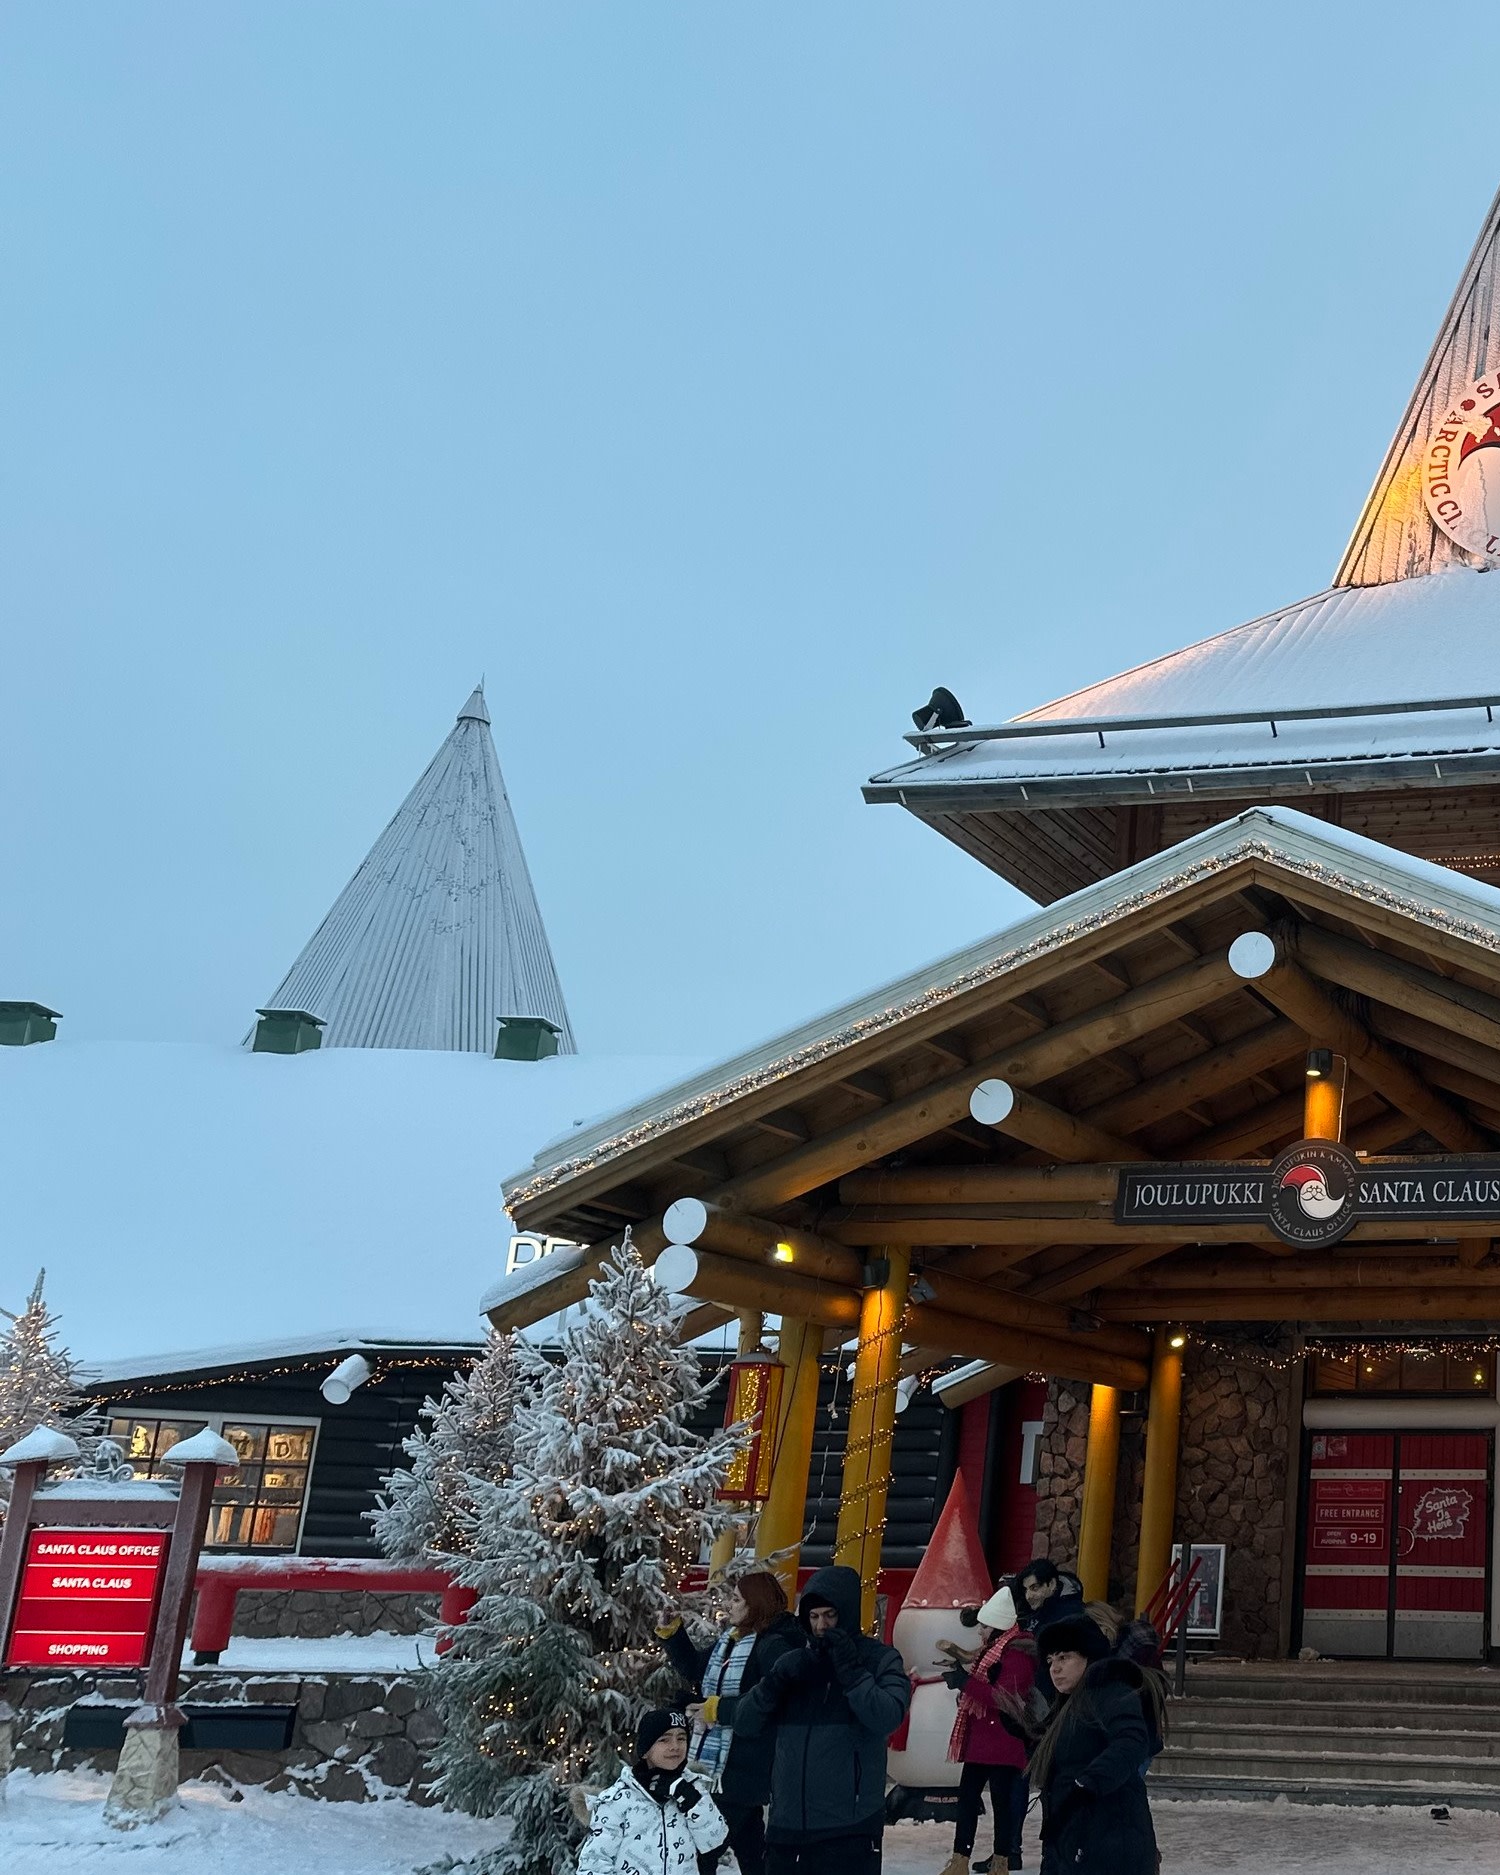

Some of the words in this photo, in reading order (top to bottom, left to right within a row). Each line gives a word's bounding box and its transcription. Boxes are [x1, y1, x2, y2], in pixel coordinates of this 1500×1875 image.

[1271, 1151, 1317, 1189] JOULUPUKIN
[1319, 1151, 1355, 1188] KAMMARI
[1133, 1183, 1264, 1209] JOULUPUKKI
[1358, 1182, 1425, 1204] SANTA
[1431, 1180, 1500, 1202] CLAUS
[1272, 1201, 1291, 1231] SANTA
[1293, 1227, 1324, 1237] CLAUS
[1326, 1201, 1352, 1231] OFFICE
[1425, 1496, 1458, 1514] Santa
[1320, 1509, 1338, 1518] FREE
[1341, 1509, 1380, 1518] ENTRANCE
[1350, 1532, 1376, 1544] 9-19
[38, 1544, 76, 1555] SANTA
[77, 1544, 117, 1556] CLAUS
[119, 1545, 161, 1556] OFFICE
[52, 1577, 91, 1588] SANTA
[92, 1578, 132, 1589] CLAUS
[48, 1644, 108, 1655] SHOPPING
